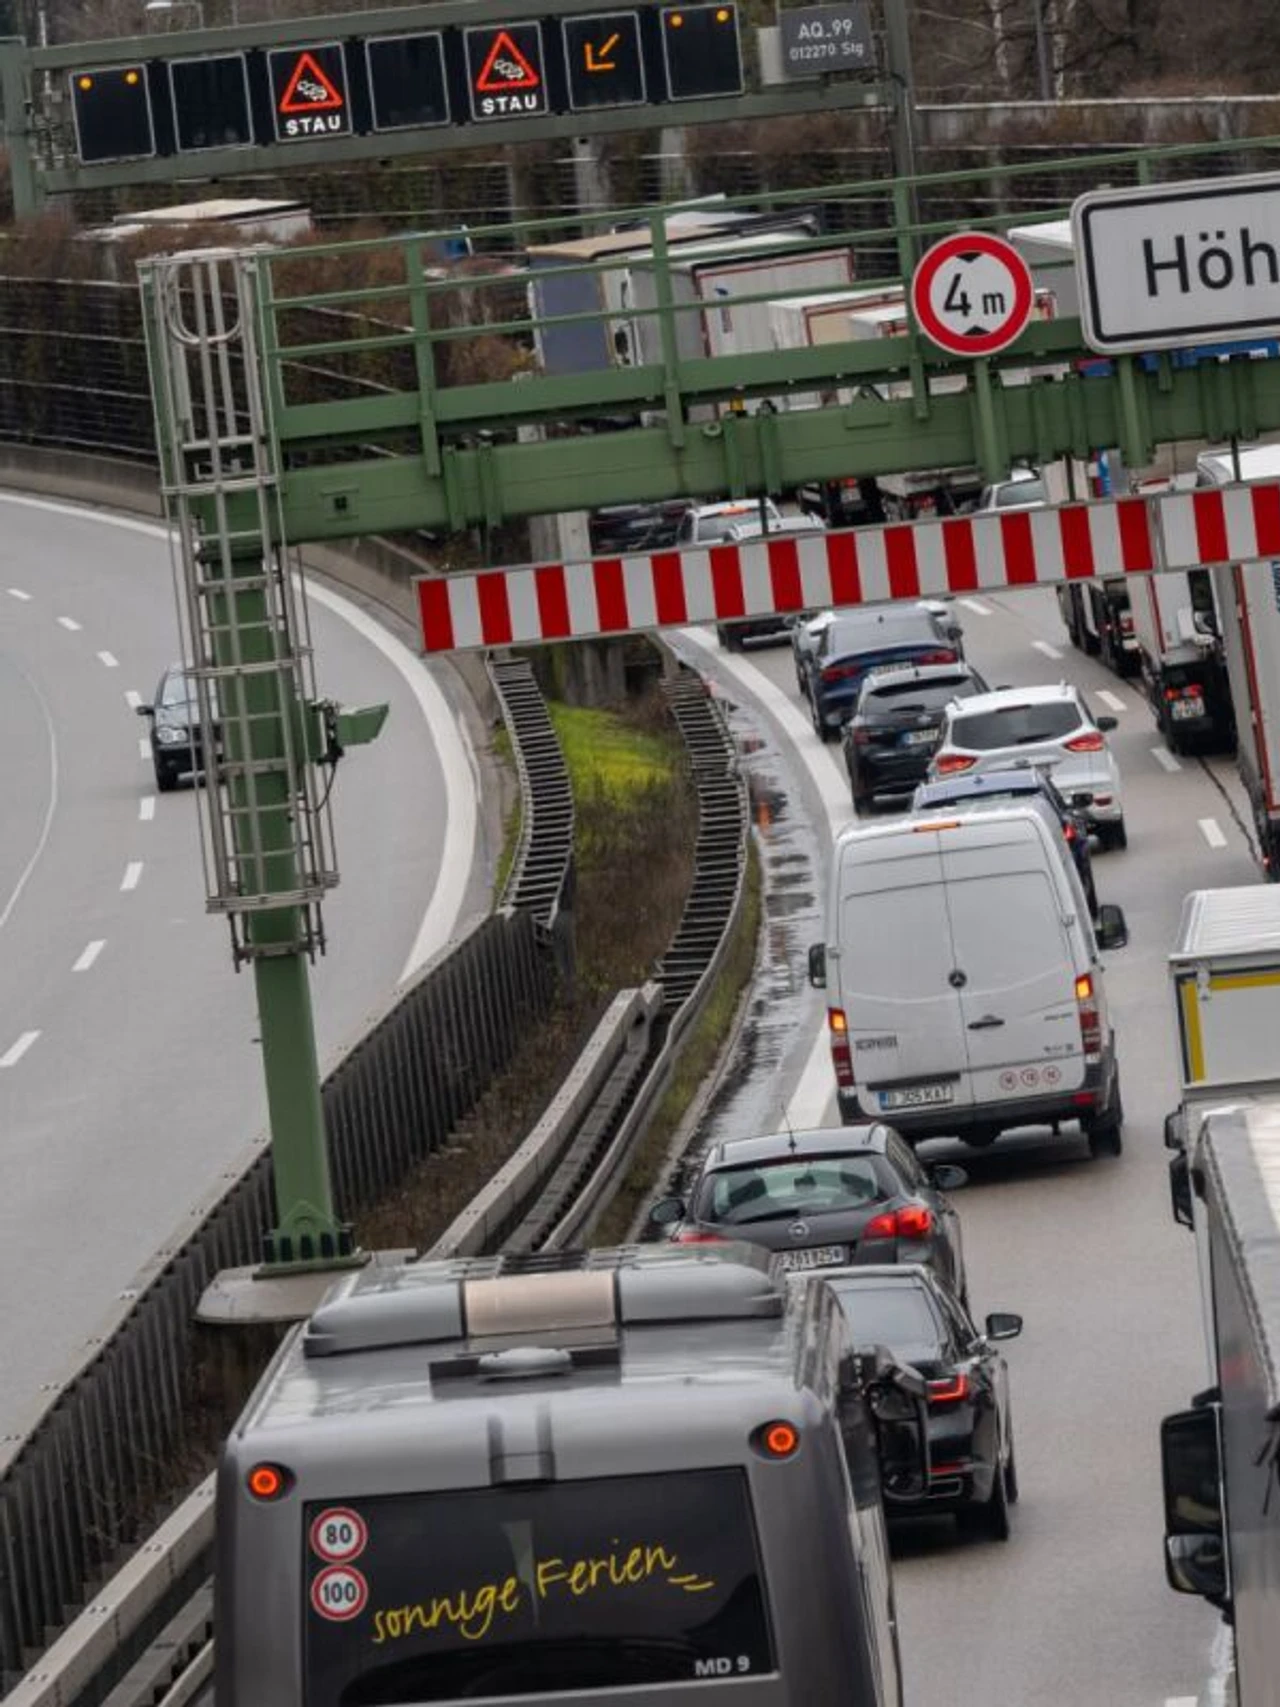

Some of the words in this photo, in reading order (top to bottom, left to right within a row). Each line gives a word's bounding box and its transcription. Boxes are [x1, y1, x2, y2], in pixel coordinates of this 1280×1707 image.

[482, 94, 538, 114] STAU
[285, 115, 342, 136] STAU
[944, 273, 972, 316] 4
[982, 292, 1006, 315] m
[326, 1523, 352, 1546] 80
[323, 1582, 357, 1604] 100
[372, 1576, 519, 1643] sonnige
[536, 1539, 677, 1598] Ferien
[695, 1656, 732, 1677] MD
[737, 1655, 750, 1672] 9
